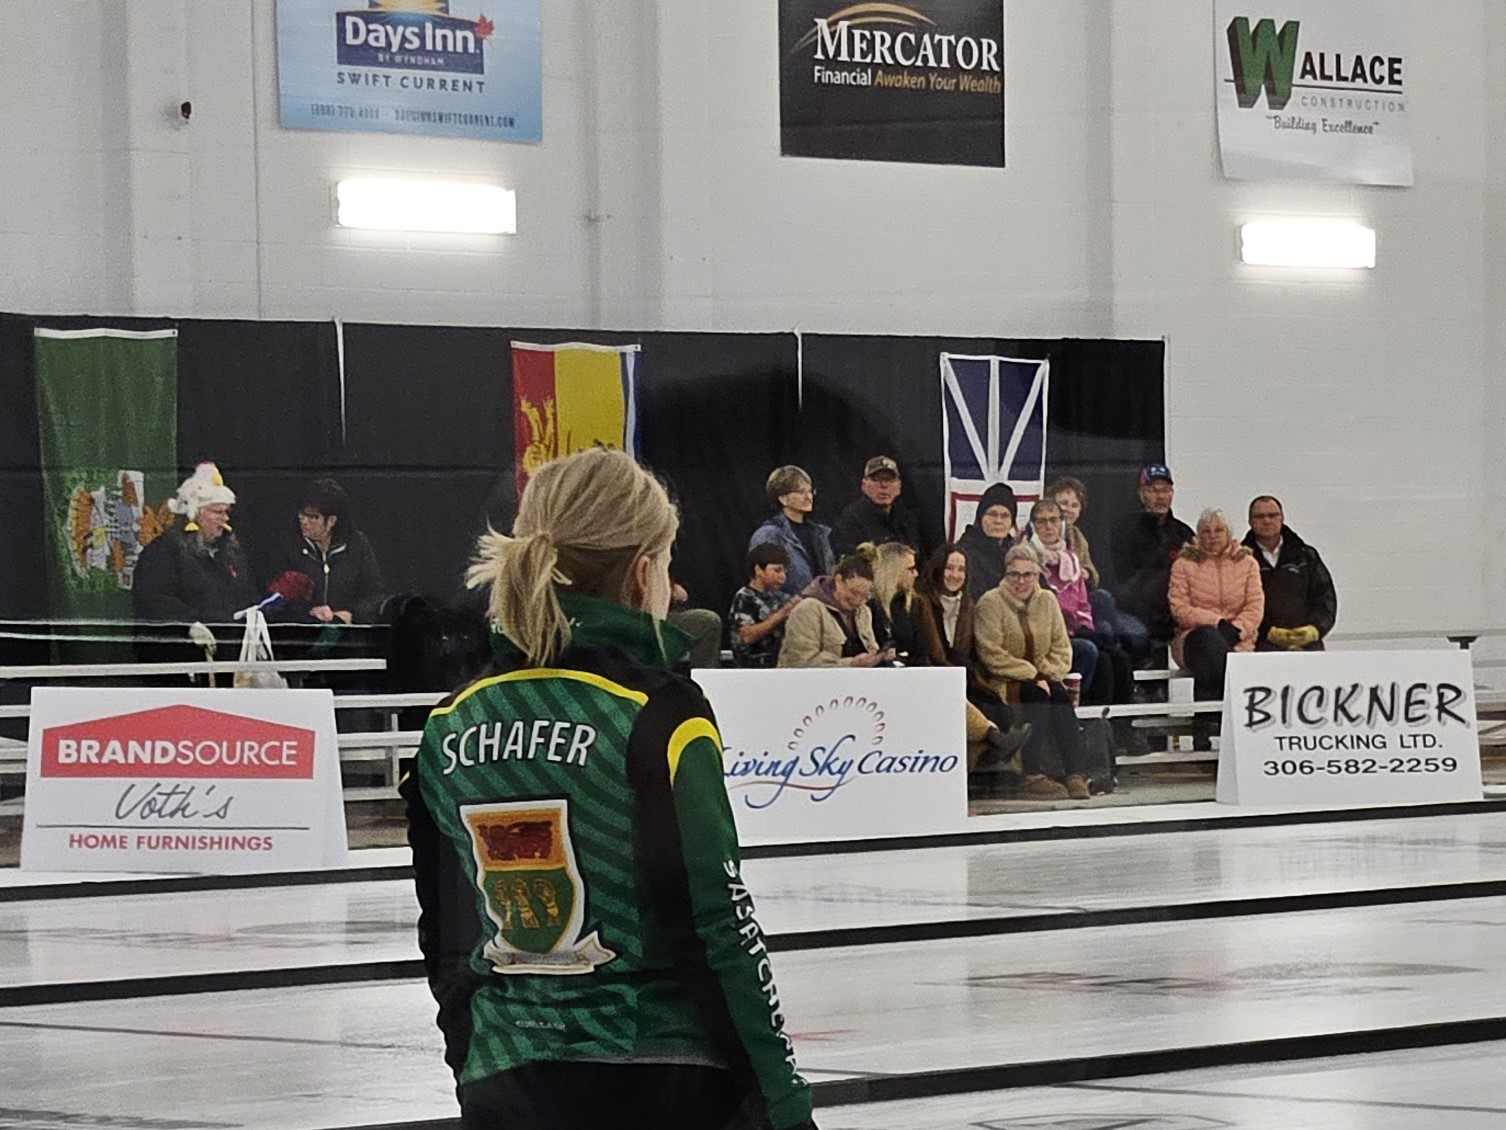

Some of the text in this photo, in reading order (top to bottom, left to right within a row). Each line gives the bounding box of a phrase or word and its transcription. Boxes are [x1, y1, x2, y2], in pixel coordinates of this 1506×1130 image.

[345, 15, 475, 54] Days Inn
[813, 18, 1001, 72] MERCATOR
[378, 54, 446, 67] BY WYNDHAM
[1226, 16, 1403, 110] WALLACE
[336, 72, 486, 94] SWIFT CURRENT
[813, 65, 1001, 94] Financial Awaken Your Wealth
[1301, 95, 1406, 113] CONSTRUCTION
[1243, 681, 1469, 730] BICKNER
[57, 739, 298, 766] BRANDSOURCE
[442, 719, 597, 776] SCHAFER
[1275, 733, 1443, 751] TRUCKING LTD.
[800, 734, 856, 802] Sky
[858, 749, 958, 775] Casino
[1263, 757, 1458, 776] 306-582-2259
[114, 782, 235, 821] Voth's
[69, 834, 273, 851] HOME FURNISHINGS
